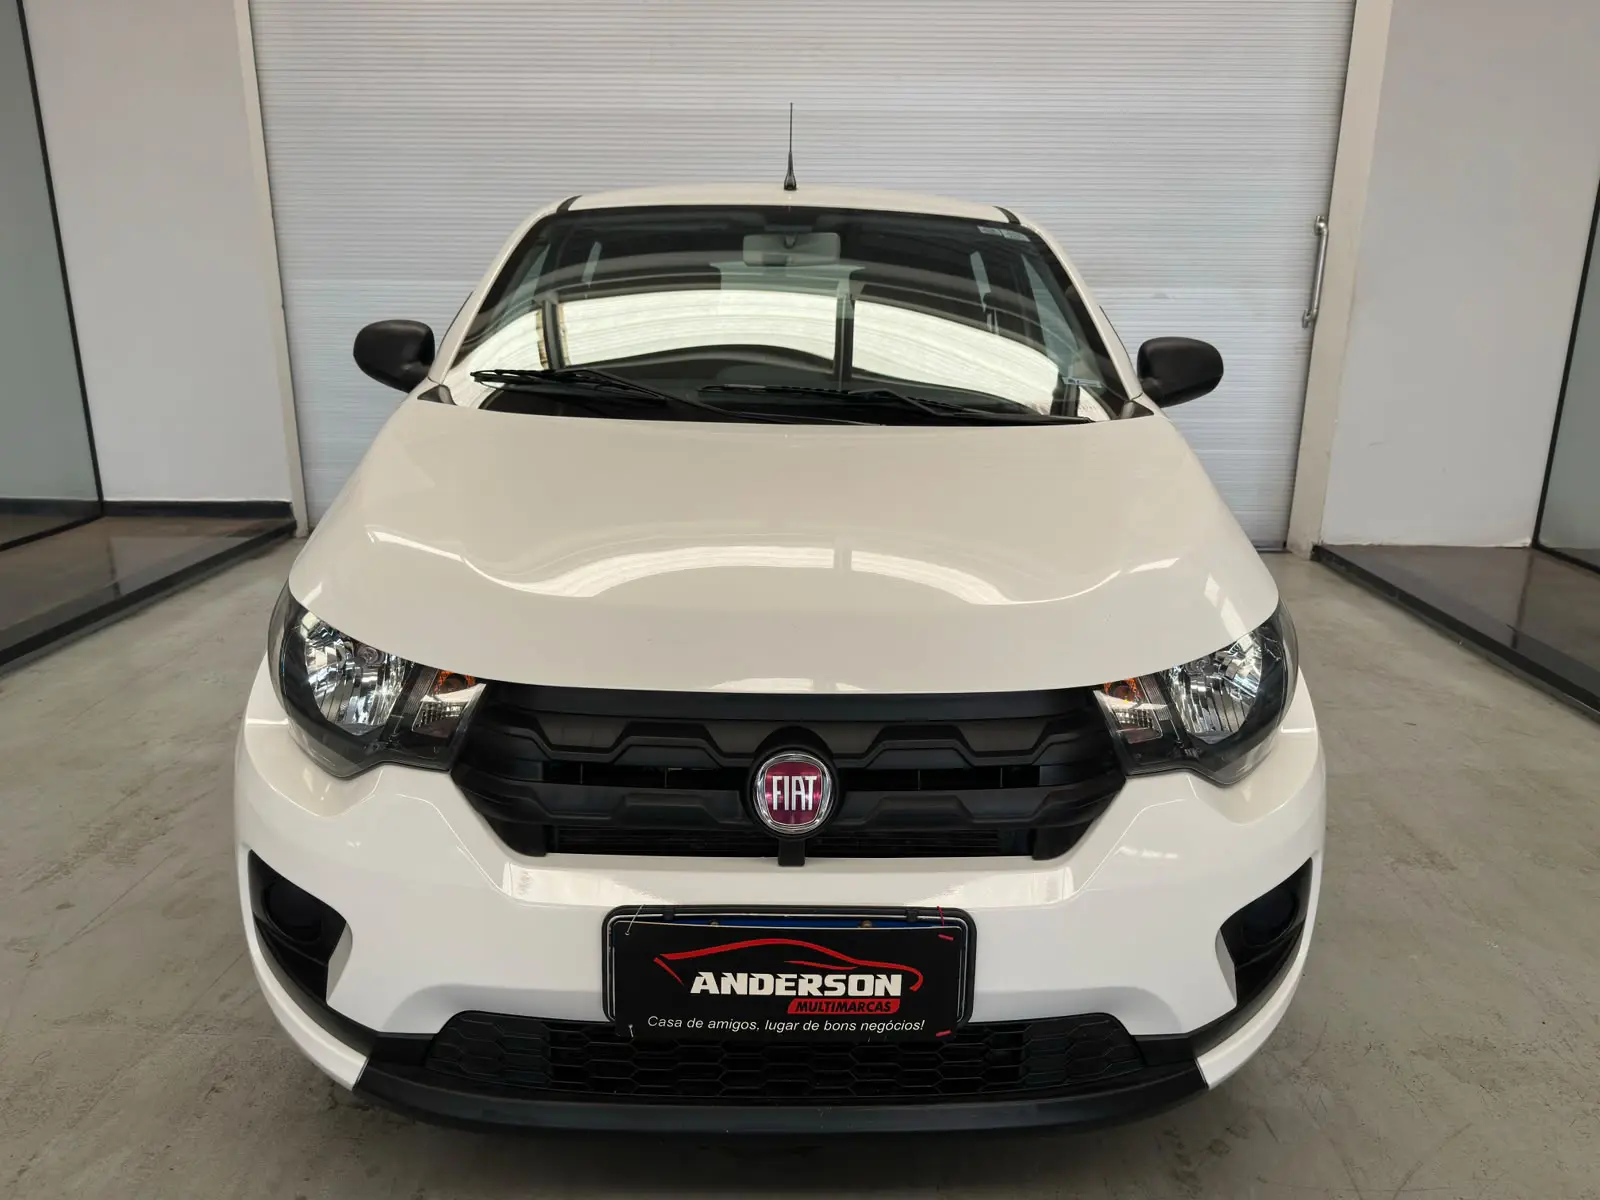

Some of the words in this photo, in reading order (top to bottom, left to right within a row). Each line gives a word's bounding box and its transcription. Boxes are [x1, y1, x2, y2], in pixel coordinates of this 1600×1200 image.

[772, 775, 818, 811] FIAT
[690, 972, 902, 997] ANDERSON
[794, 1000, 892, 1013] MULTIMARCAS
[647, 1015, 683, 1028] Casa
[686, 1018, 704, 1029] de
[707, 1018, 760, 1032] amigos,
[764, 1019, 800, 1033] lugar
[802, 1020, 820, 1031] de
[823, 1020, 857, 1031] bons
[860, 1019, 926, 1033] negócios!
